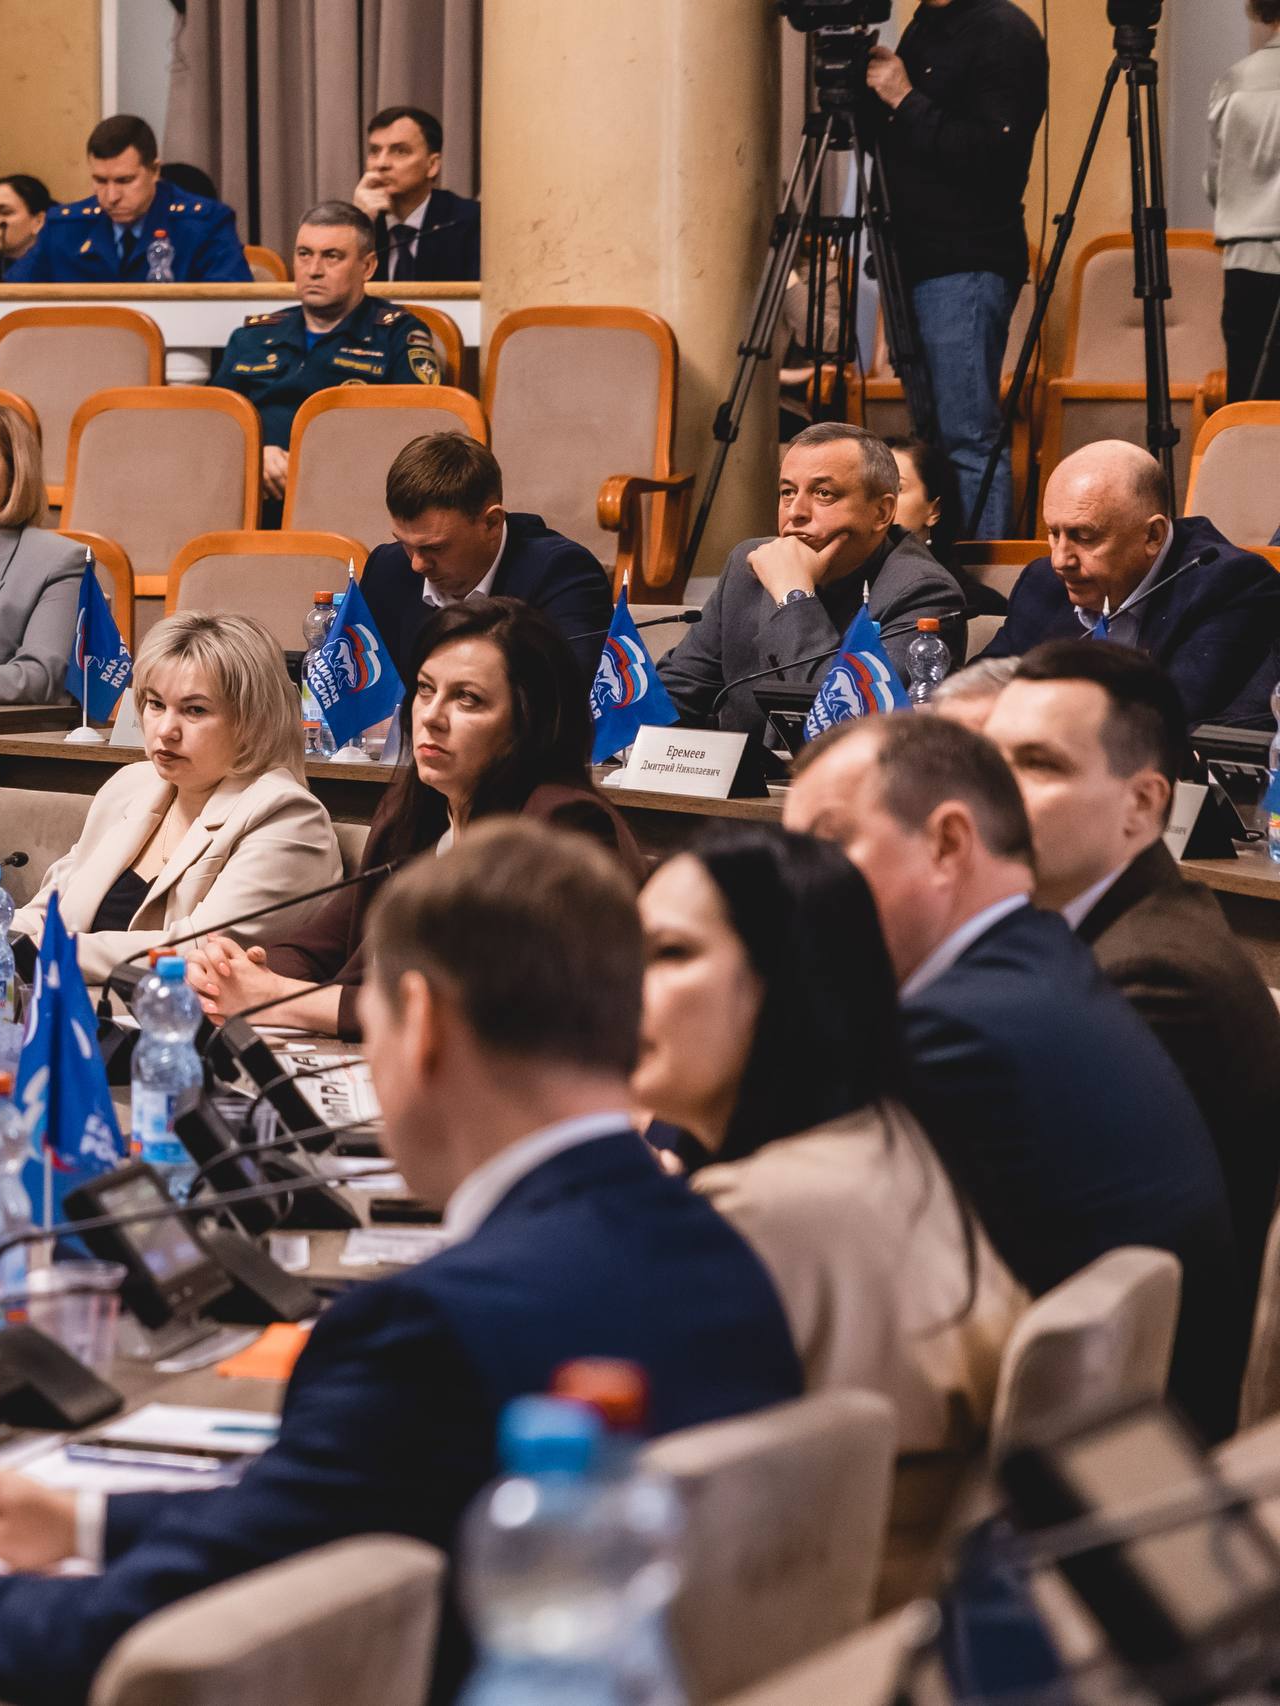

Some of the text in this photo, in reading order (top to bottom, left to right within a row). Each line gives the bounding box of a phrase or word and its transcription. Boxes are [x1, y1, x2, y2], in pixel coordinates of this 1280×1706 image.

[666, 745, 706, 760] Еремеев
[640, 760, 721, 777] Дмитрий Николаевич
